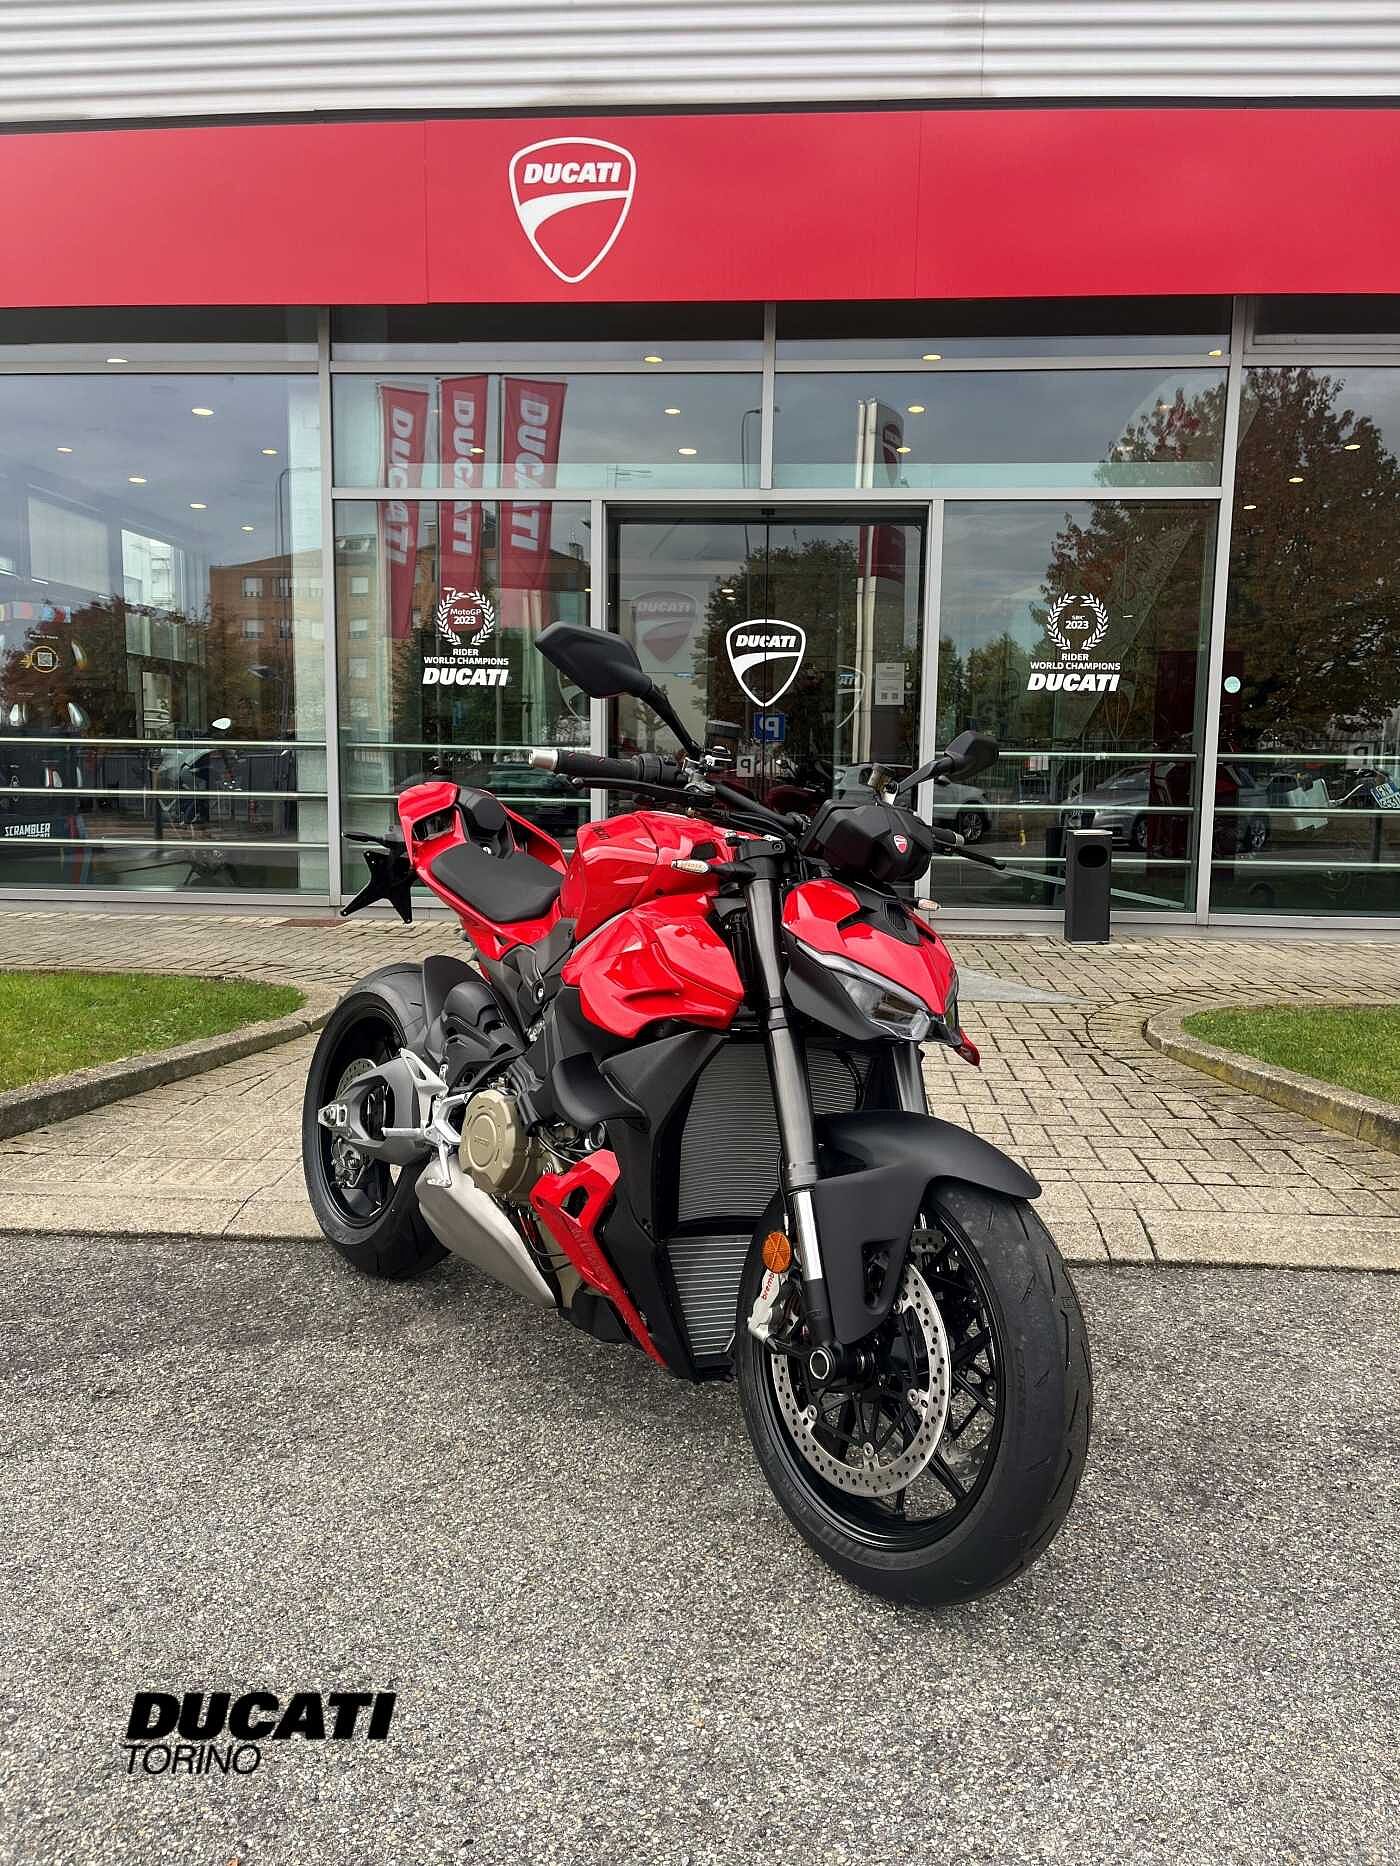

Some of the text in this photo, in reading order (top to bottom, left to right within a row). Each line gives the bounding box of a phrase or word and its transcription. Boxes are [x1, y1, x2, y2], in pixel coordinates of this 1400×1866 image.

[523, 162, 622, 184] DUCATI
[453, 397, 475, 554] DUCATI
[510, 397, 550, 551] DUCATI
[384, 407, 414, 566] DUCATI
[450, 608, 482, 616] MotoGP
[454, 616, 476, 625] 2023
[1065, 620, 1089, 630] 2023
[736, 635, 797, 648] DUCATI
[452, 648, 479, 656] RIDER
[1061, 653, 1089, 661] RIDER
[423, 656, 509, 666] WORLD CHAMPIONS
[1030, 661, 1121, 671] WORLD CHAMPIONS
[422, 667, 509, 687] DUCATI
[1027, 673, 1120, 692] DUCATI
[4, 822, 51, 837] SCRAMBLER
[761, 1272, 775, 1300] bremb
